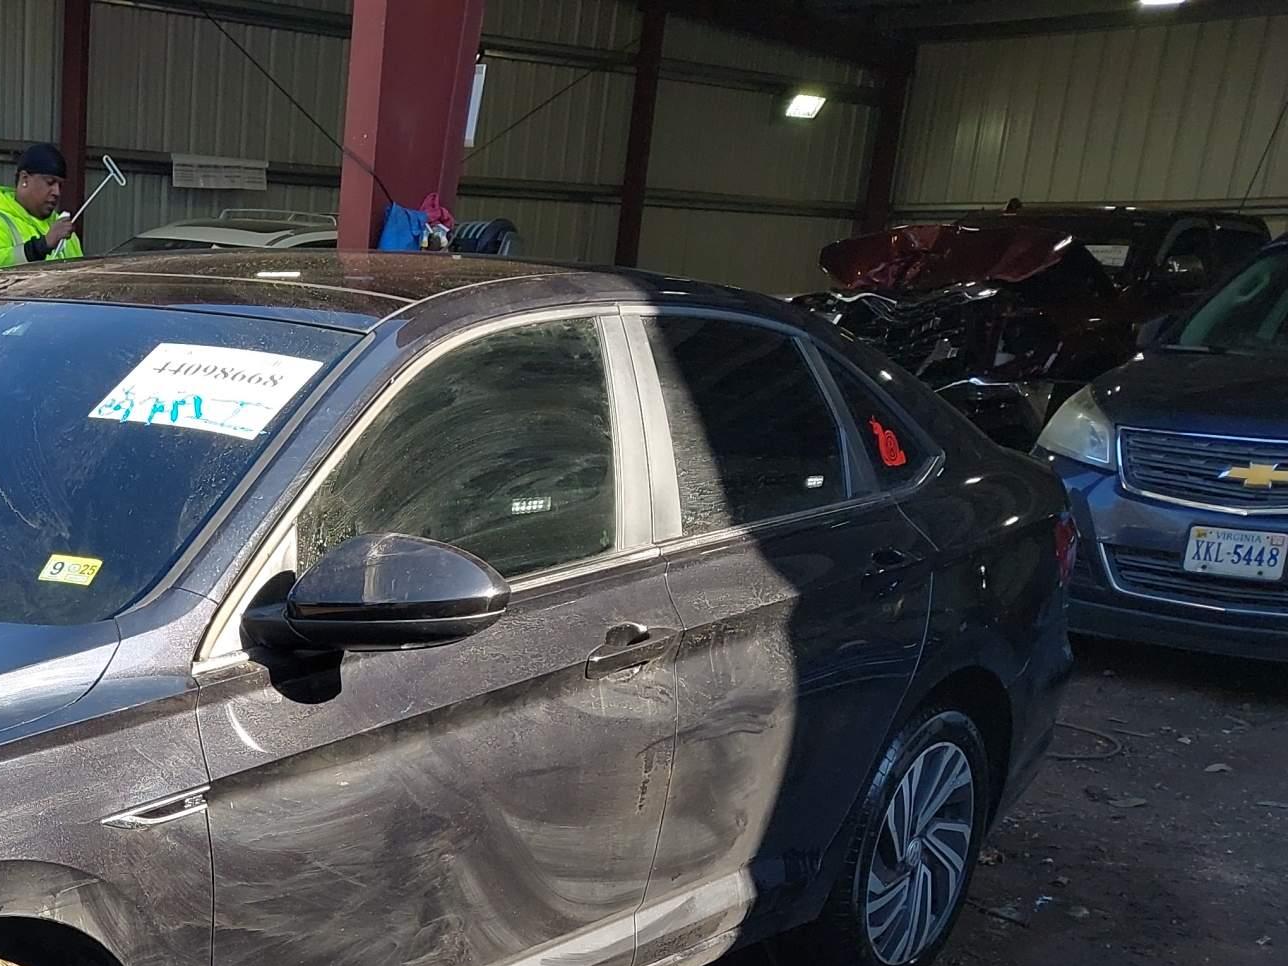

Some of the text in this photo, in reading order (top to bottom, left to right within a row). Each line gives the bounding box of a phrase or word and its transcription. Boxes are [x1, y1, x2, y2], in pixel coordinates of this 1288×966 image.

[153, 360, 284, 388] 44098668
[1215, 531, 1262, 543] VIRGINIA
[1191, 539, 1280, 568] XKL-5448
[49, 561, 98, 576] 9 25
